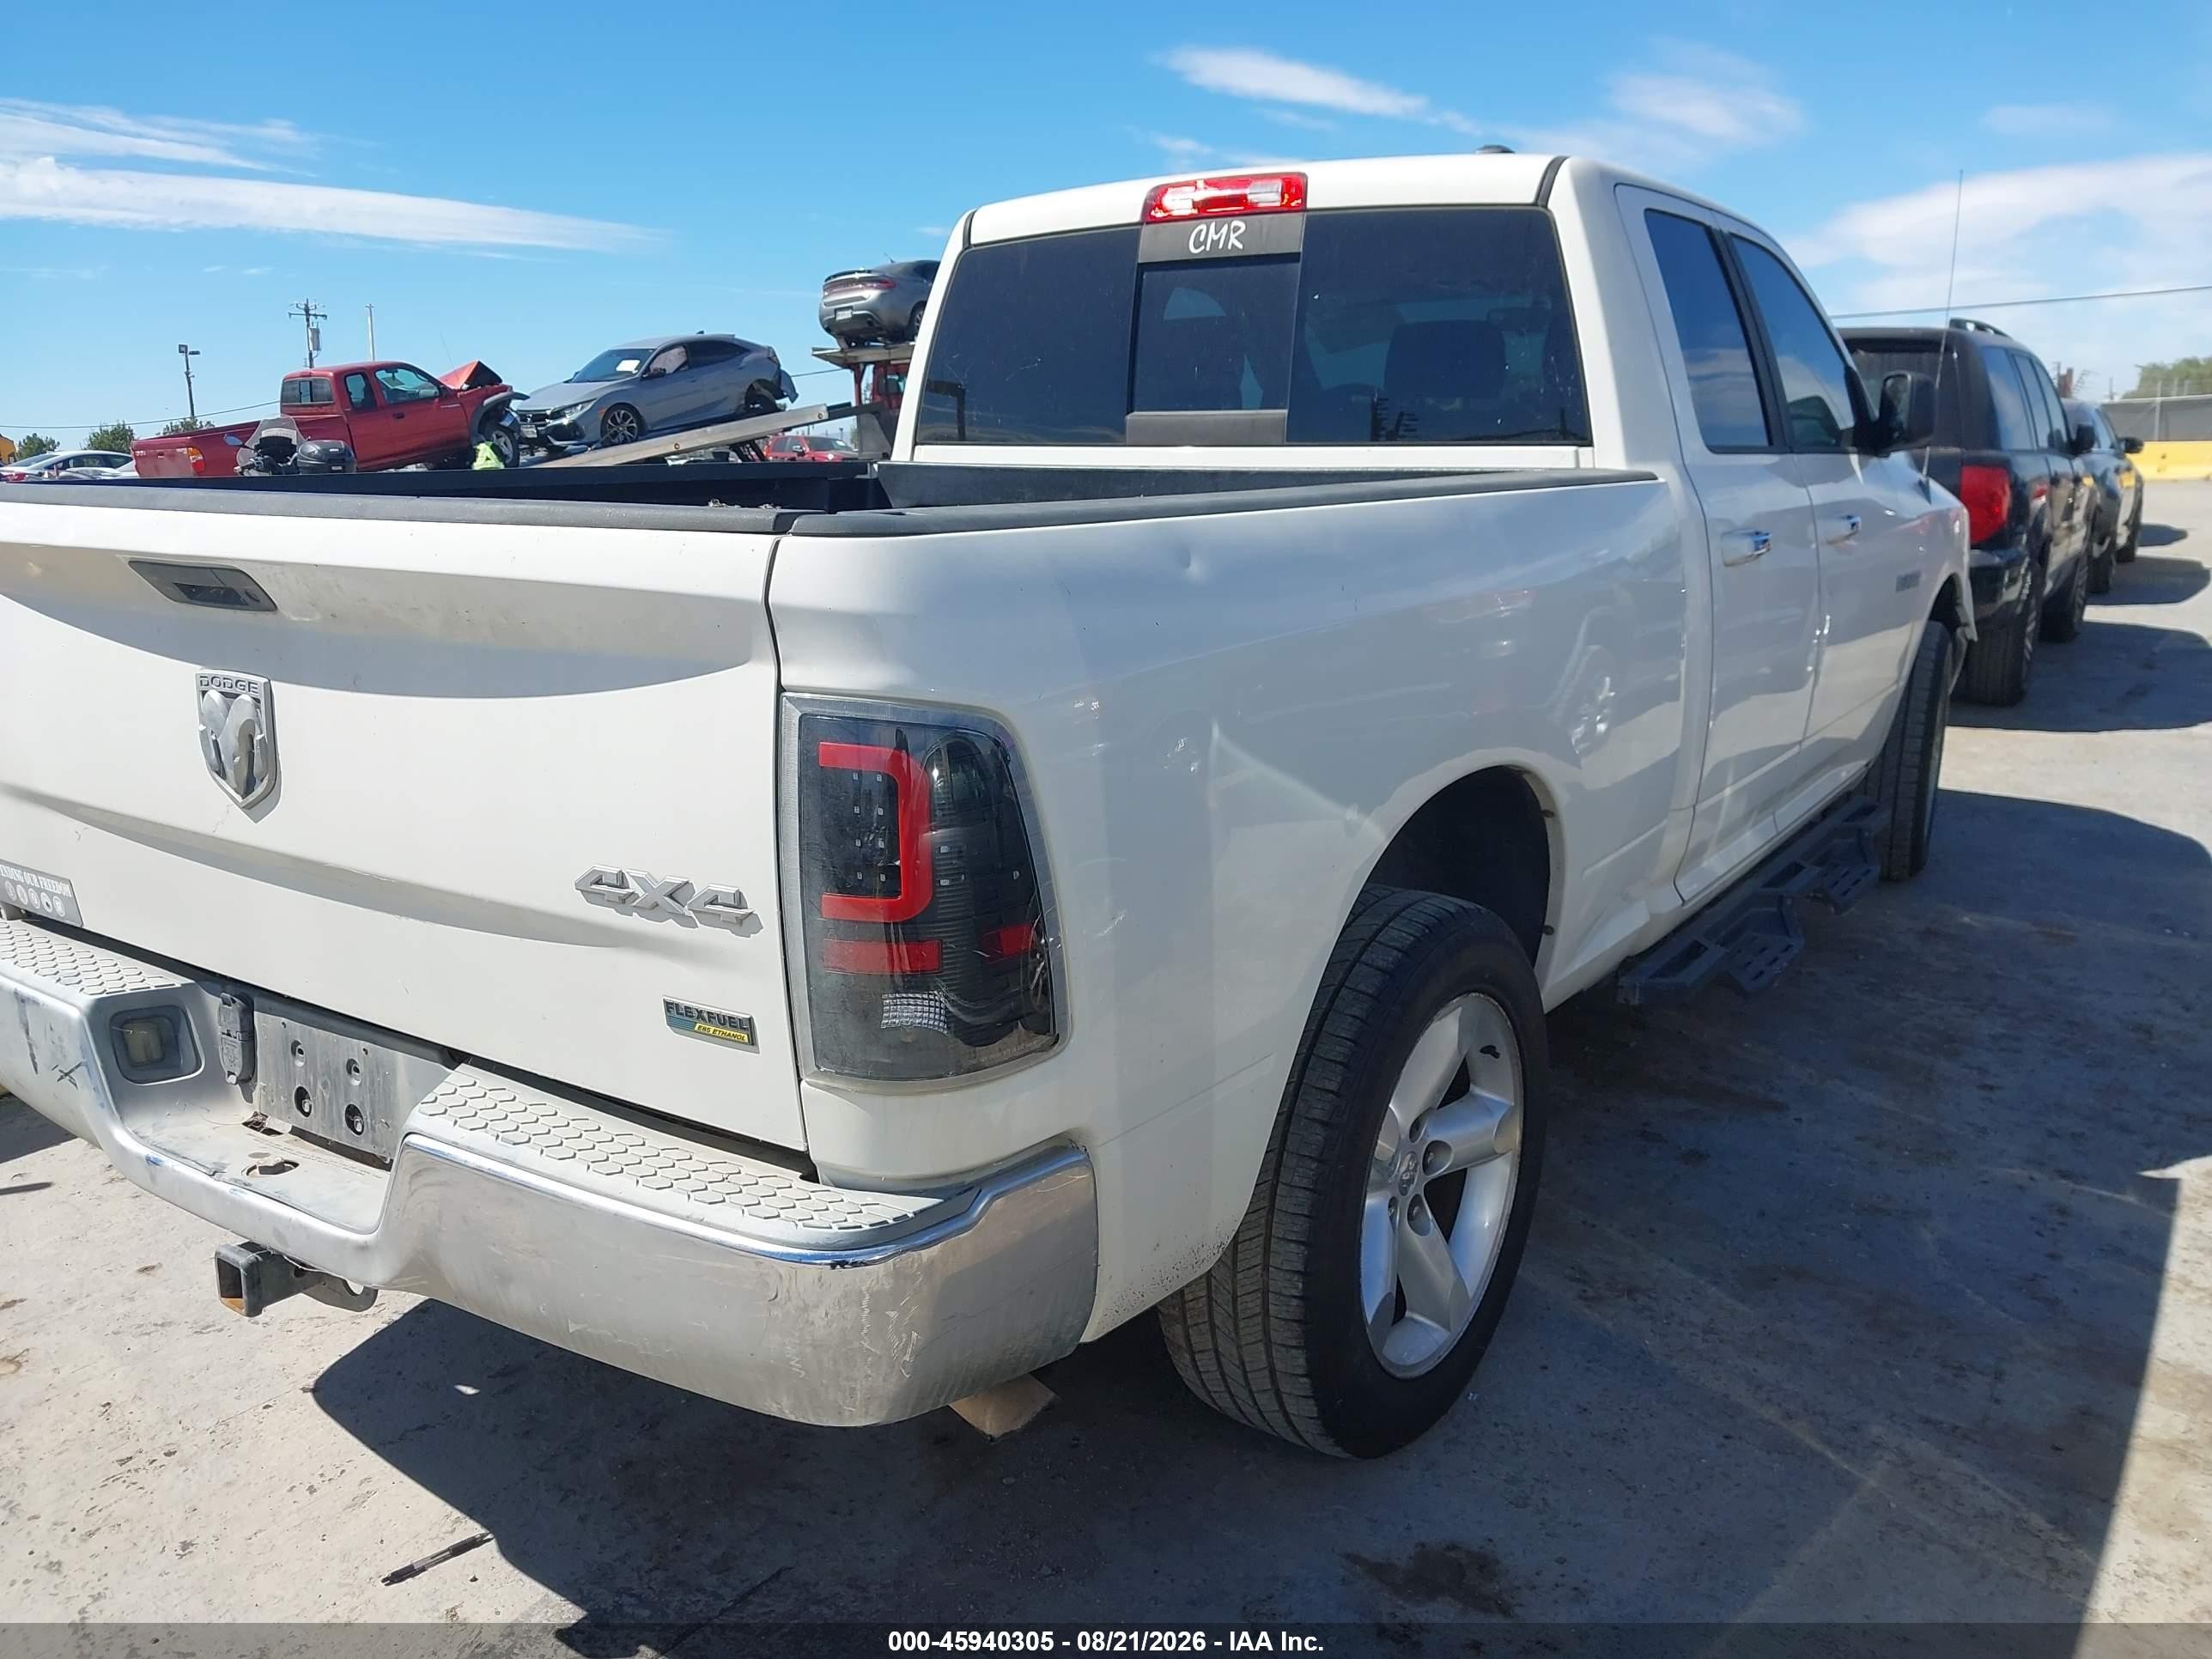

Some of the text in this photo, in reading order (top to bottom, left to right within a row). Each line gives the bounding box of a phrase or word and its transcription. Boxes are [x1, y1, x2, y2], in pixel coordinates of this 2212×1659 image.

[1188, 220, 1246, 254] CMR
[199, 675, 259, 695] DODGE
[696, 1024, 746, 1042] E85 ETHANOL
